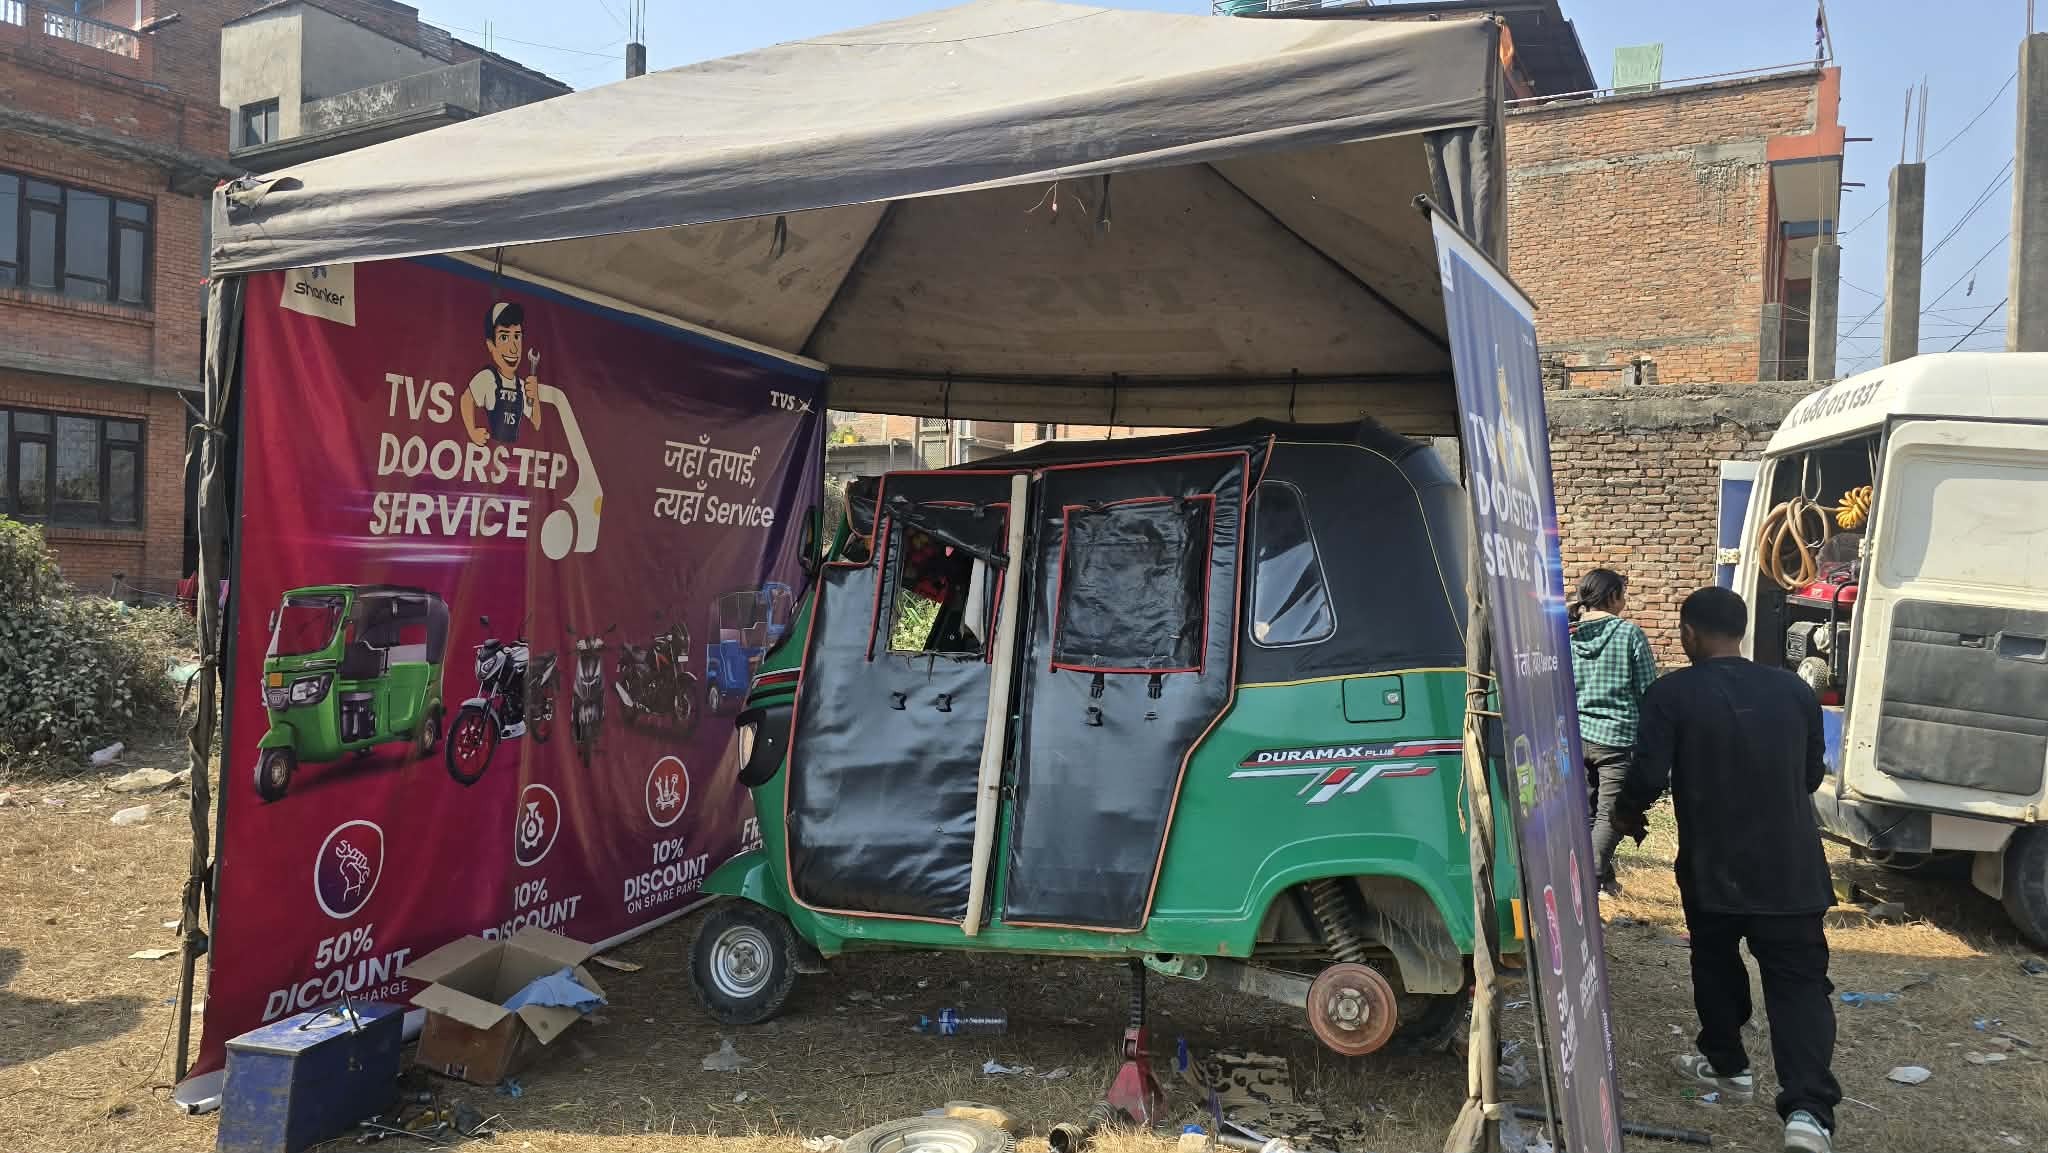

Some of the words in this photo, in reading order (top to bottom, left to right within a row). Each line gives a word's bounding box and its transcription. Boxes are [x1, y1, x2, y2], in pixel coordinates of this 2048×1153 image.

[385, 373, 455, 424] TVS
[770, 391, 796, 411] TVS
[1848, 379, 1885, 410] 1337
[503, 412, 516, 425] TVS
[377, 432, 568, 489] DOORSTEP
[664, 433, 710, 478] जहाँ
[369, 491, 530, 538] SERVICE
[654, 480, 708, 525] त्यहाँ
[705, 495, 775, 528] Service
[1257, 746, 1364, 763] DURAMAX
[652, 836, 685, 865] 10%
[514, 877, 549, 911] 10%
[624, 853, 709, 903] DISCOUNT
[627, 898, 642, 914] ON
[644, 887, 675, 908] SPARE
[676, 877, 703, 897] PARTS
[314, 923, 374, 970] 50%
[261, 947, 411, 1022] DICOUNT
